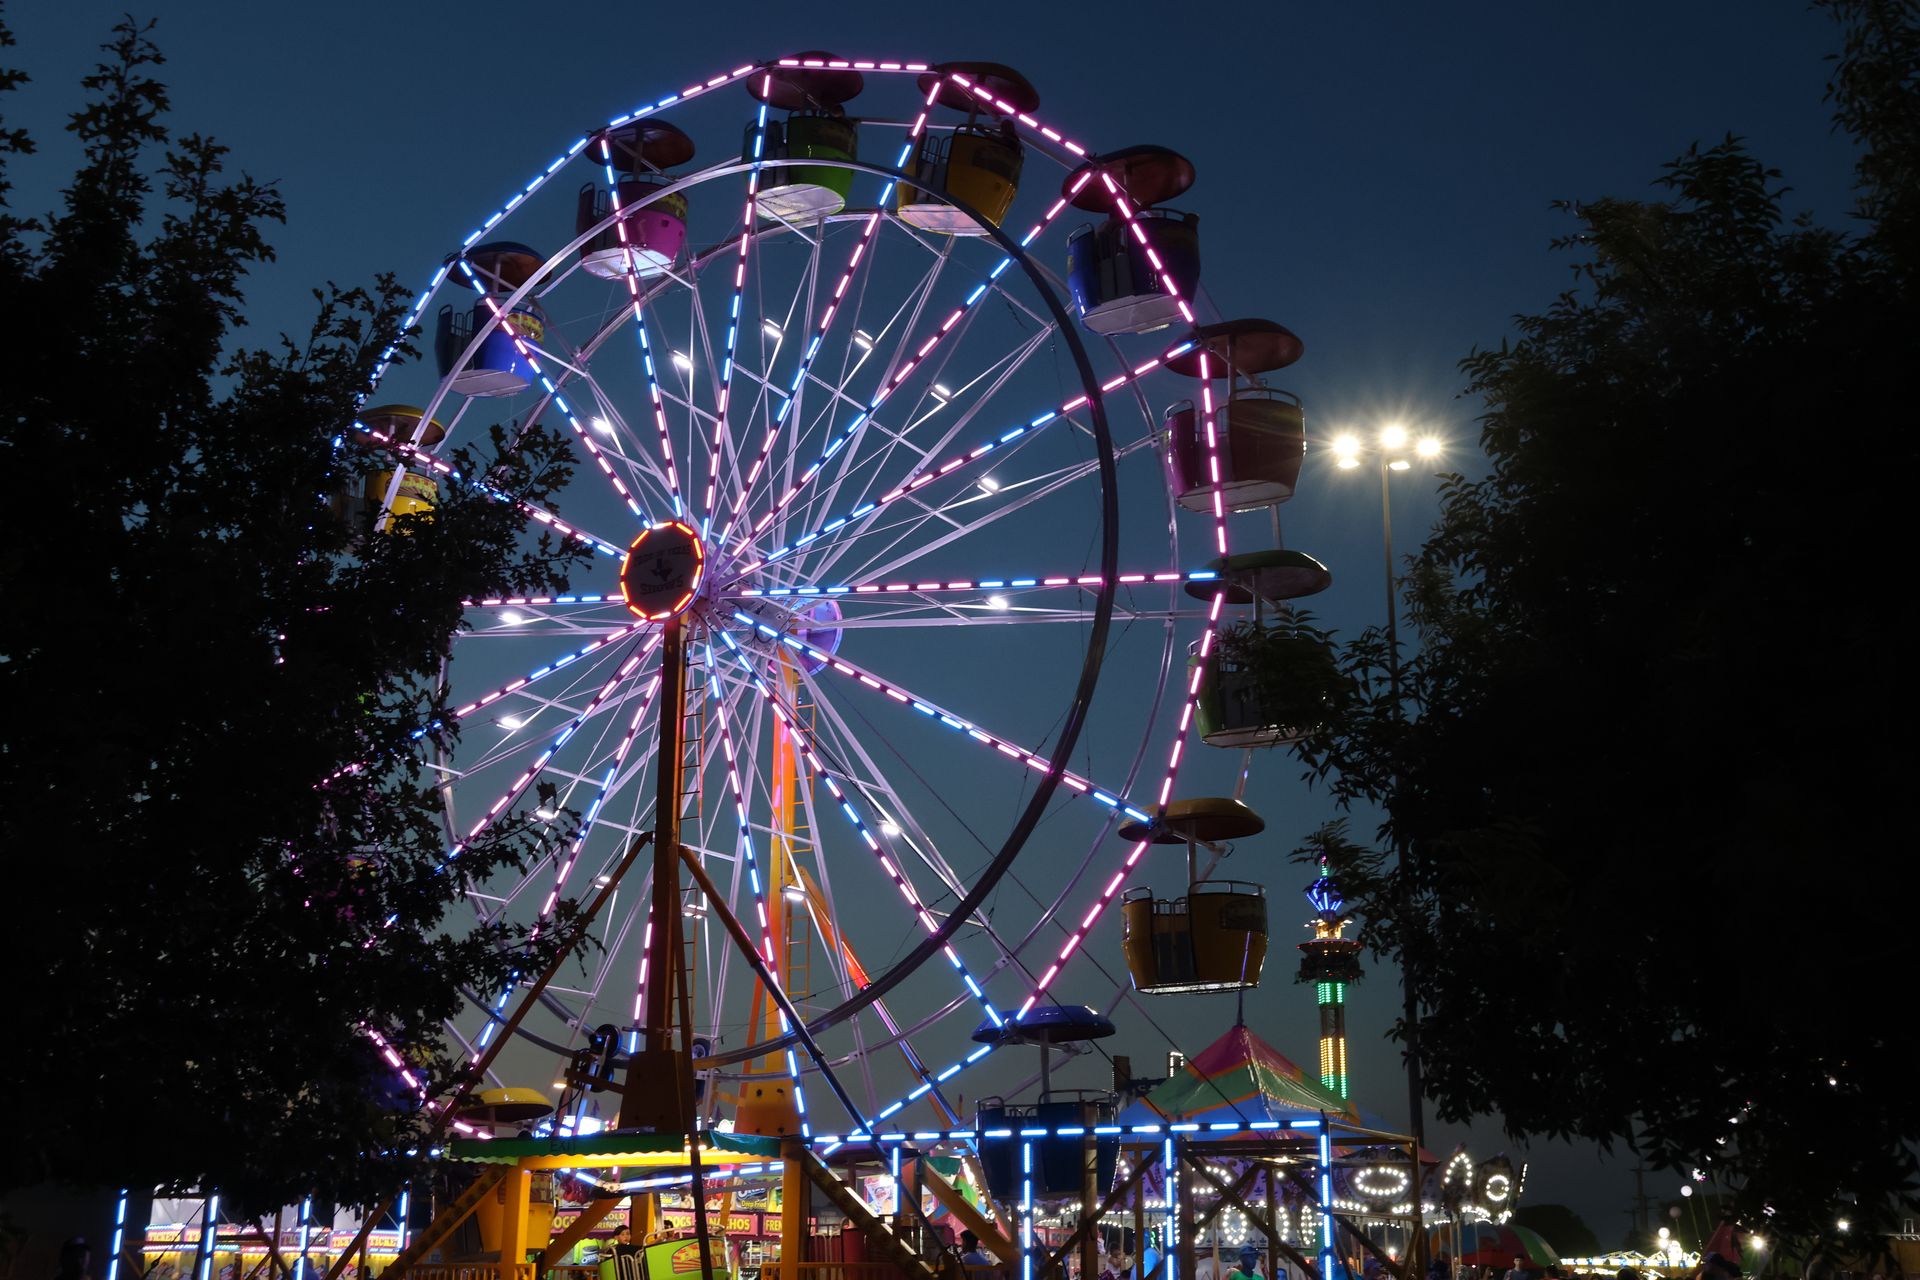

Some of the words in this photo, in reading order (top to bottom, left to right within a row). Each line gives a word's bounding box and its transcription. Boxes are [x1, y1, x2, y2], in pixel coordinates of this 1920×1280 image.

[552, 1215, 577, 1229] OGS
[605, 1213, 625, 1221] OLD
[709, 1217, 750, 1231] NAHOS
